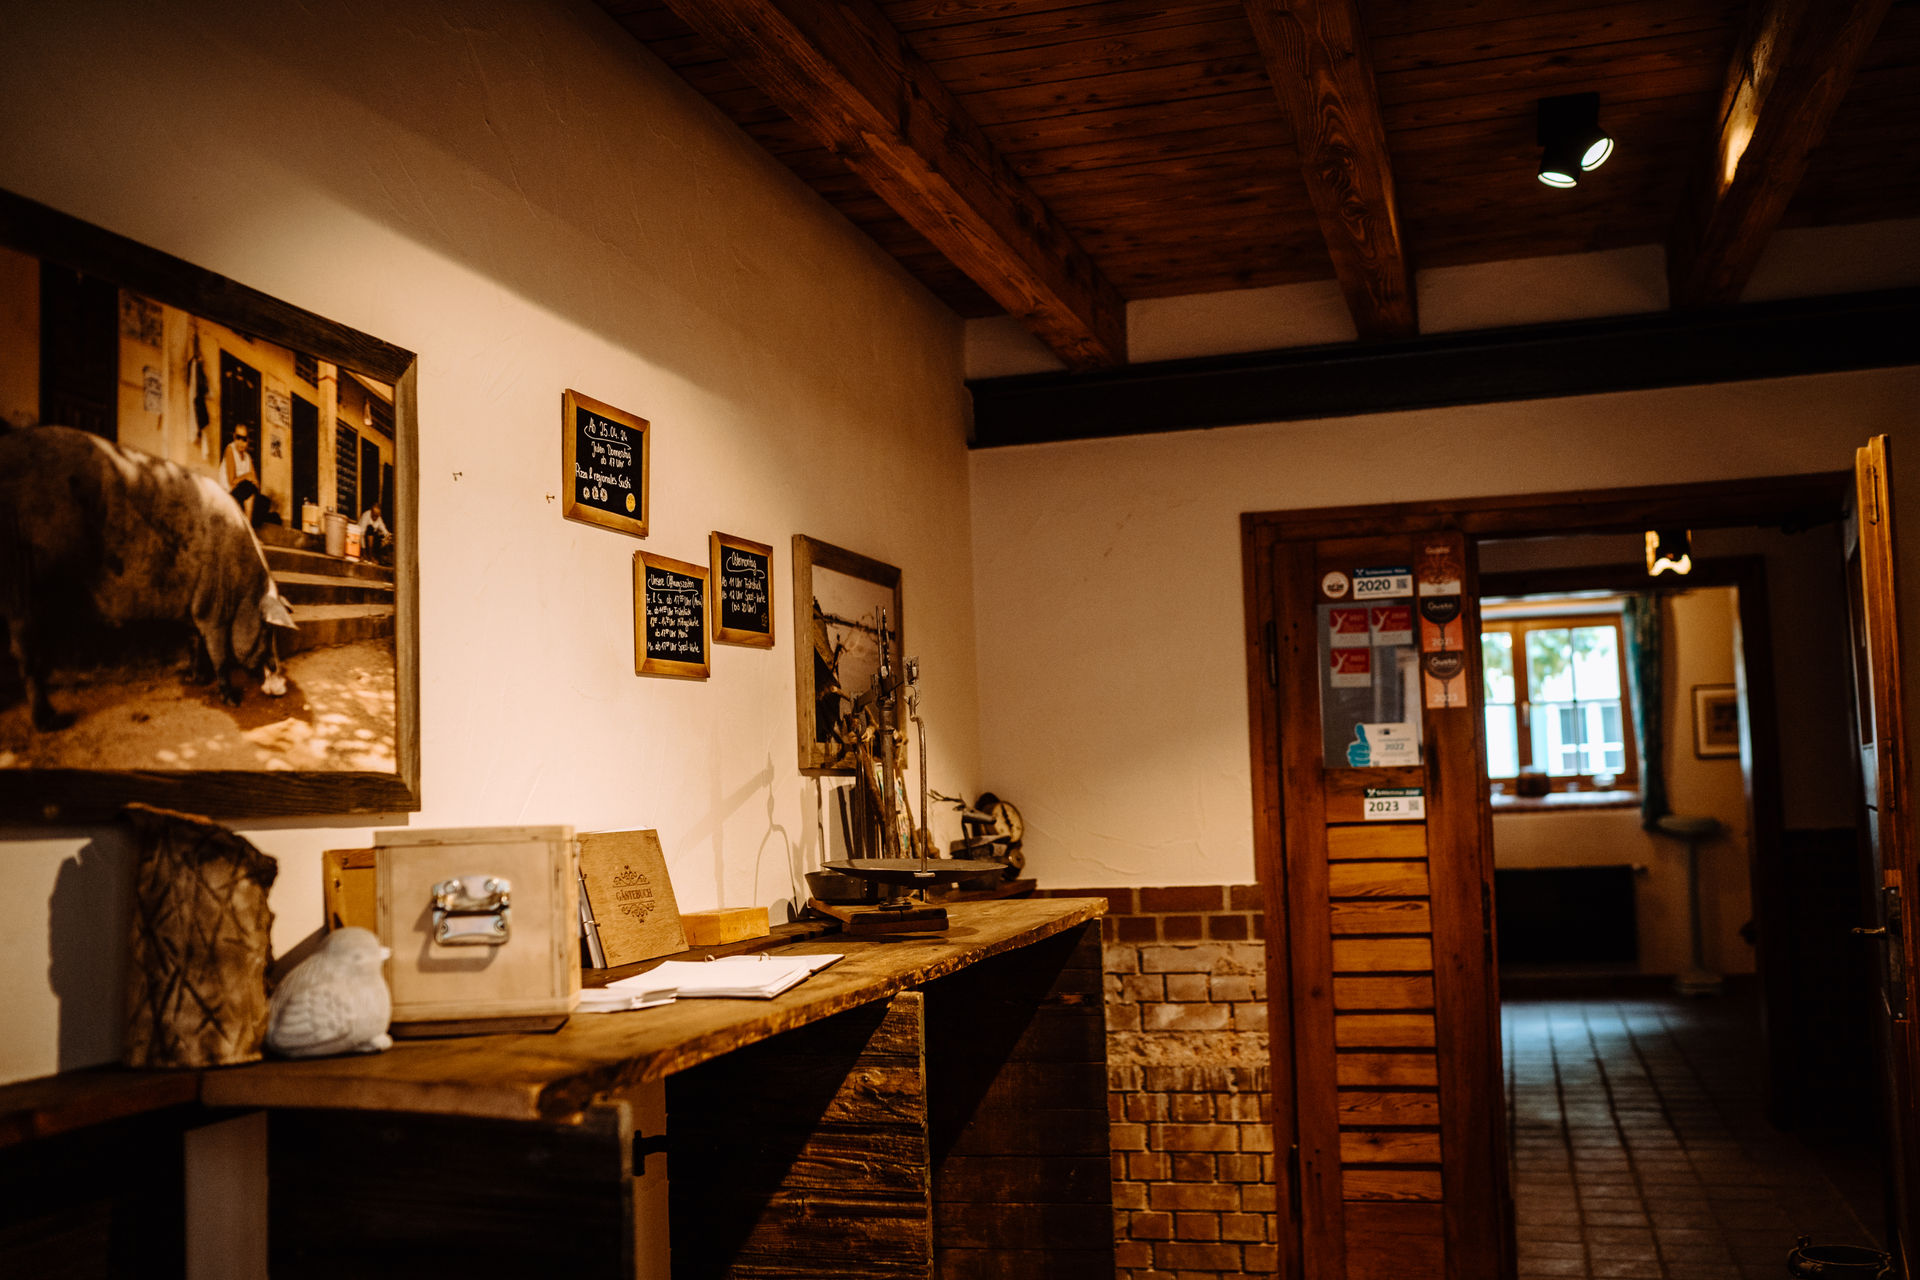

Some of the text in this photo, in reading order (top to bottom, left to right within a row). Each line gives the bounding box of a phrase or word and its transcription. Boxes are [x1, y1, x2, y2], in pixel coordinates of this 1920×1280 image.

[588, 417, 597, 434] Ab
[600, 455, 625, 469] ab 17 Uhr
[575, 462, 588, 480] Pizza
[593, 471, 618, 488] regionales
[618, 474, 632, 489] Sushi
[735, 577, 743, 588] Uhr
[1357, 579, 1391, 592] 2020
[666, 594, 673, 605] ab
[735, 590, 744, 600] Uhr
[1431, 656, 1458, 667] Gusto
[1369, 801, 1399, 812] 2023
[615, 888, 653, 902] GÄSTEBUCH
